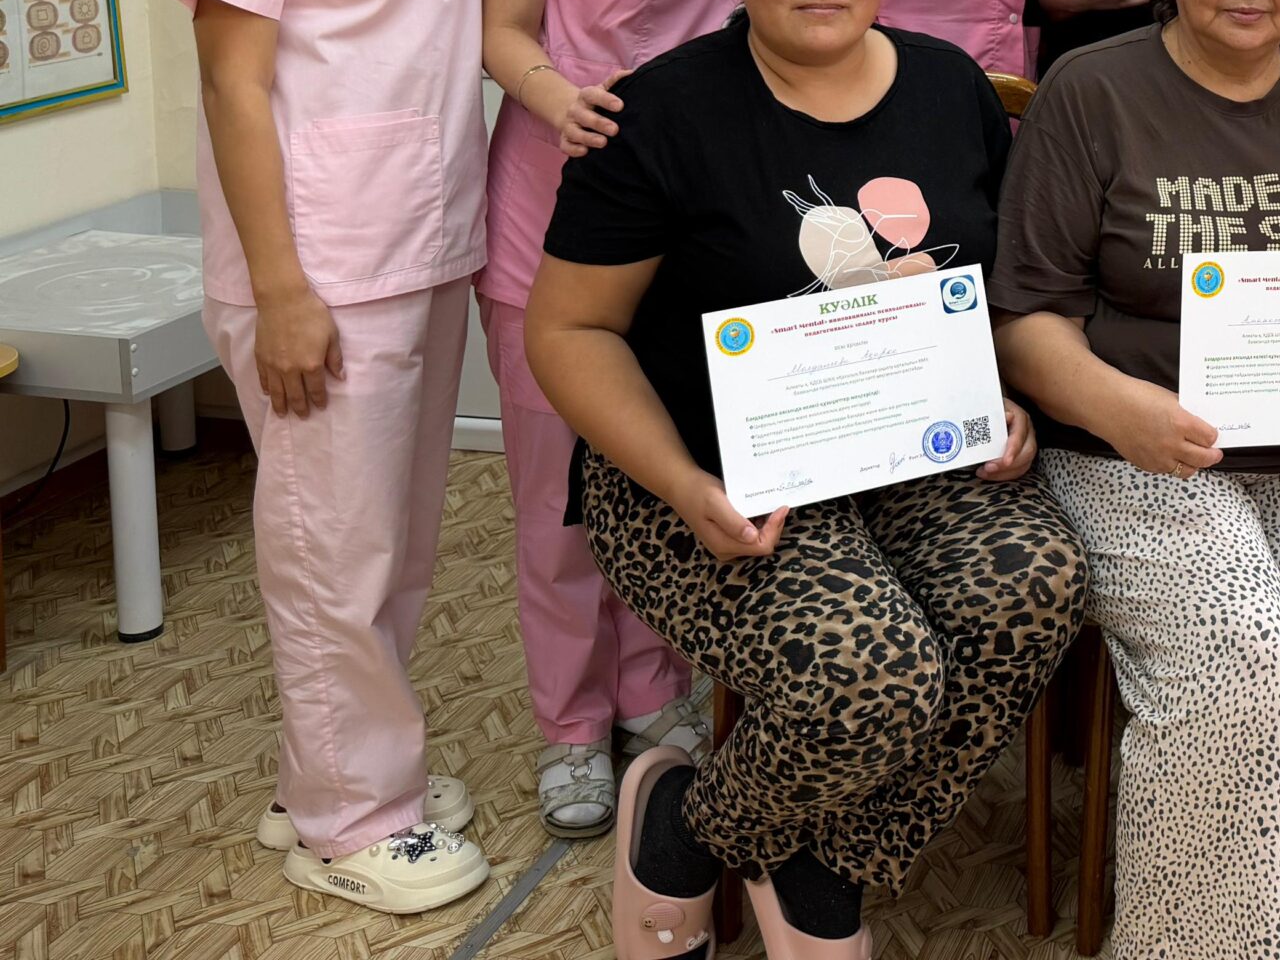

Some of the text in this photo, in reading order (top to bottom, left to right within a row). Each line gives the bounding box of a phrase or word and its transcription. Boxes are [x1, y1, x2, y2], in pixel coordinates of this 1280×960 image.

[1145, 213, 1249, 254] THE
[1143, 257, 1179, 269] ALL
[819, 293, 878, 315] КУӘЛІК
[328, 874, 367, 894] COMFORT
